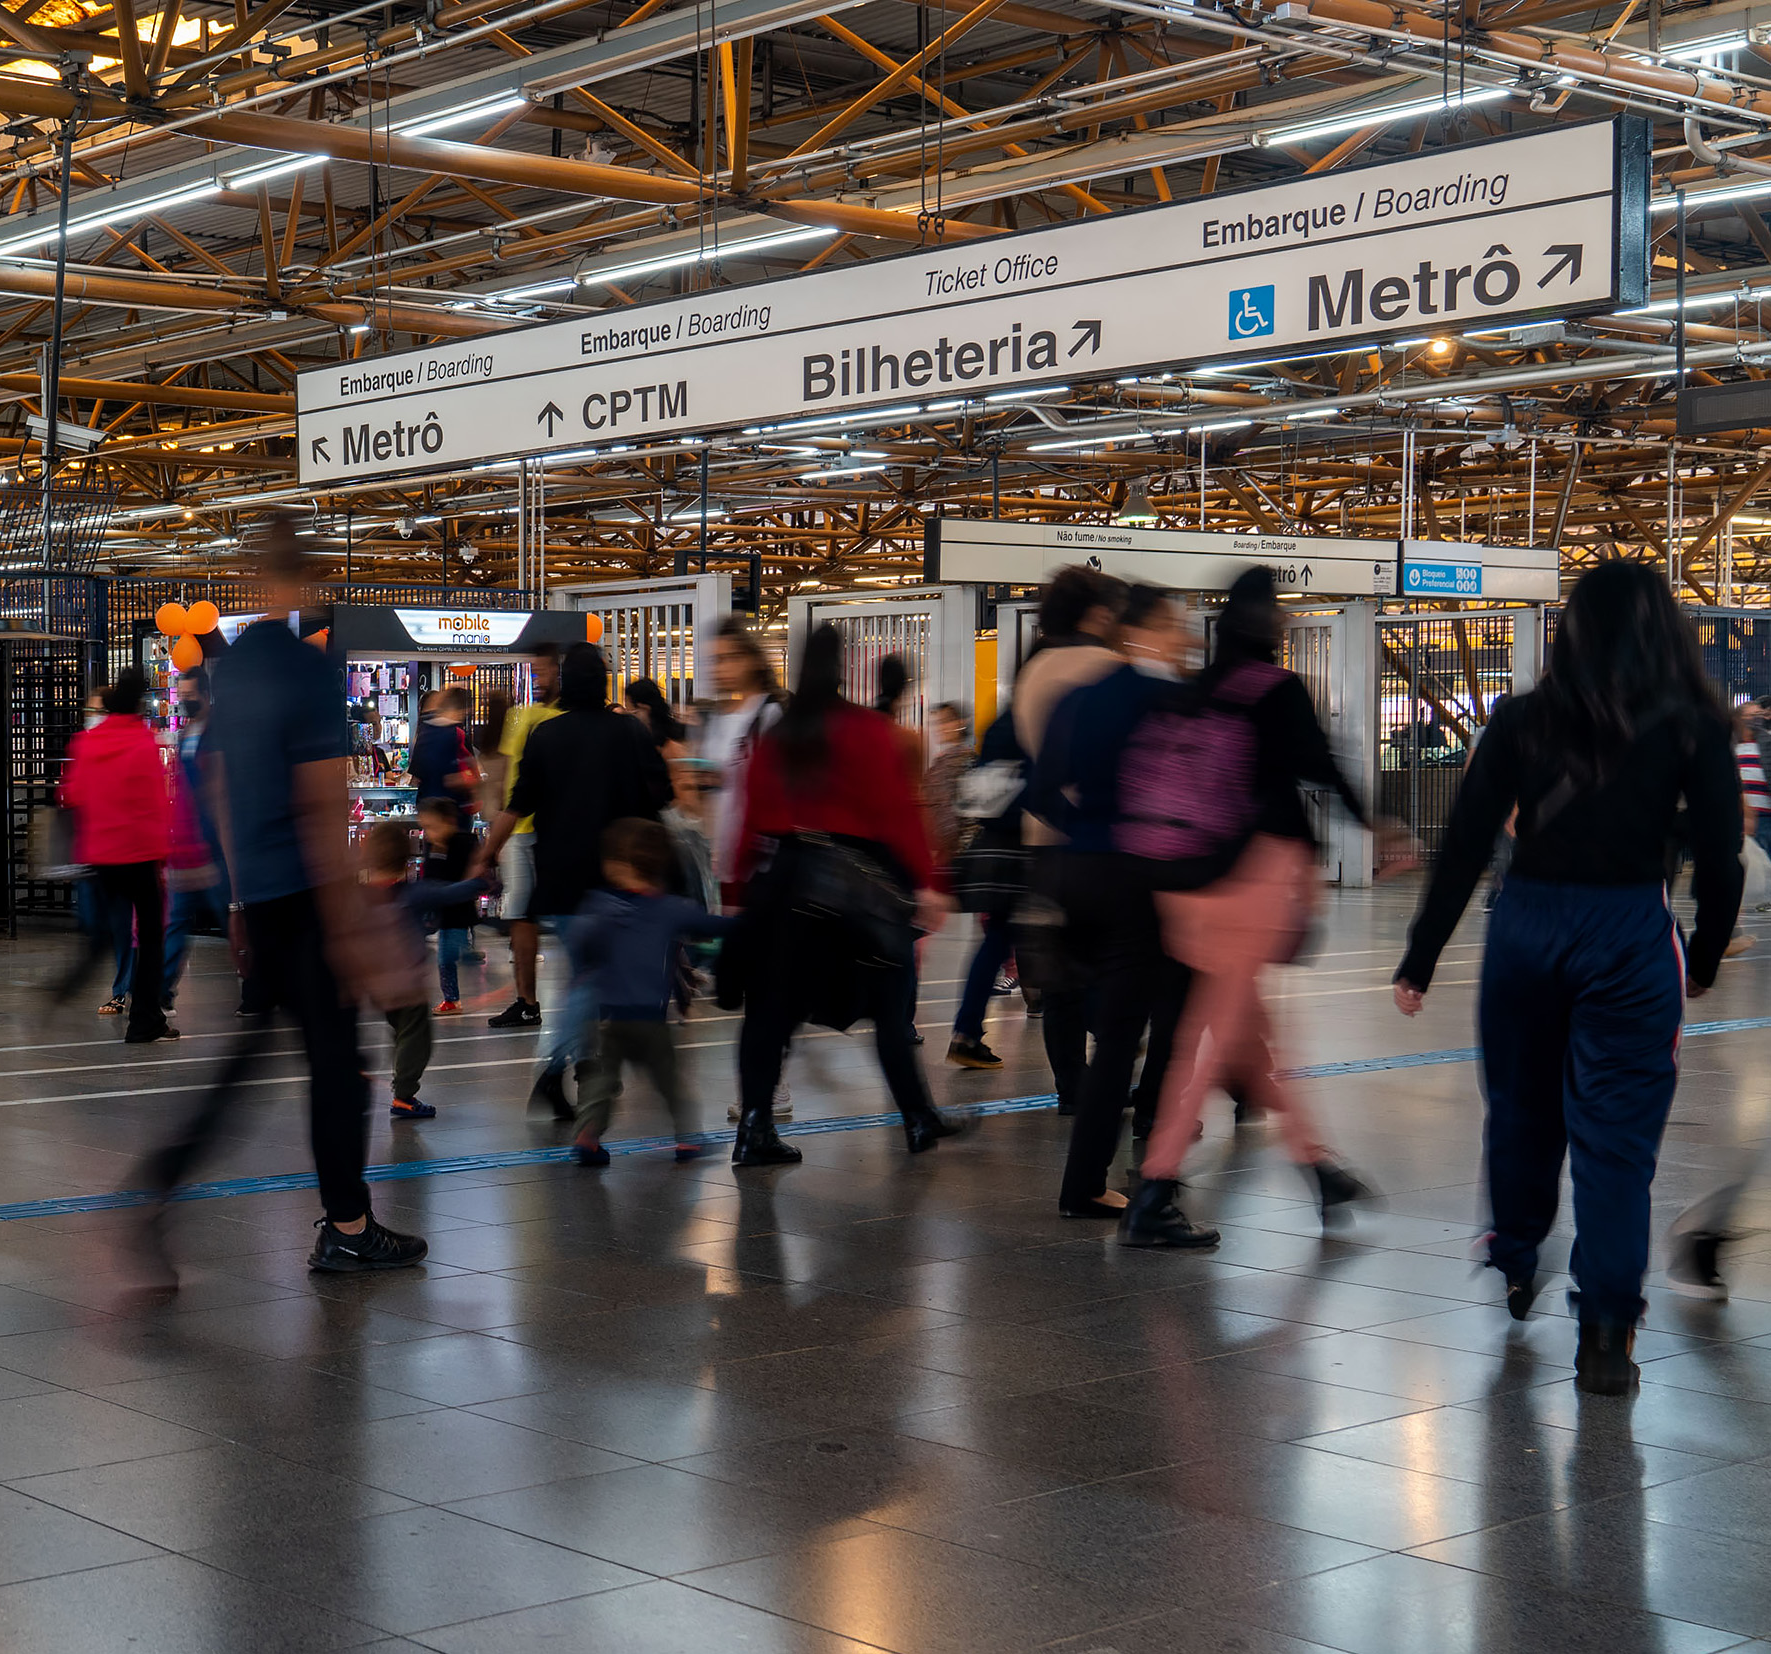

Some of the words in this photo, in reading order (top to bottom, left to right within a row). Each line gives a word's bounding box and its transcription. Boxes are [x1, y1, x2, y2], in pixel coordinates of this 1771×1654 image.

[1202, 203, 1346, 249] Embarque
[1373, 173, 1510, 206] Boarding
[925, 263, 988, 297] Ticket
[994, 253, 1059, 285] Office
[1307, 243, 1521, 332] Metrô
[581, 323, 672, 355] Embarque
[687, 304, 772, 337] Boarding
[340, 369, 414, 397] Embarque
[426, 353, 494, 382] Boarding
[803, 322, 1059, 402] Bilheteria
[582, 380, 688, 430] CPTM
[342, 411, 444, 466] Metrô
[1057, 530, 1073, 542] Não
[1108, 535, 1132, 545] smoking
[1233, 540, 1258, 550] Boarding
[1261, 540, 1297, 552] Embarque
[1271, 564, 1297, 583] etrô
[438, 613, 490, 631] mobile
[453, 632, 490, 644] mania
